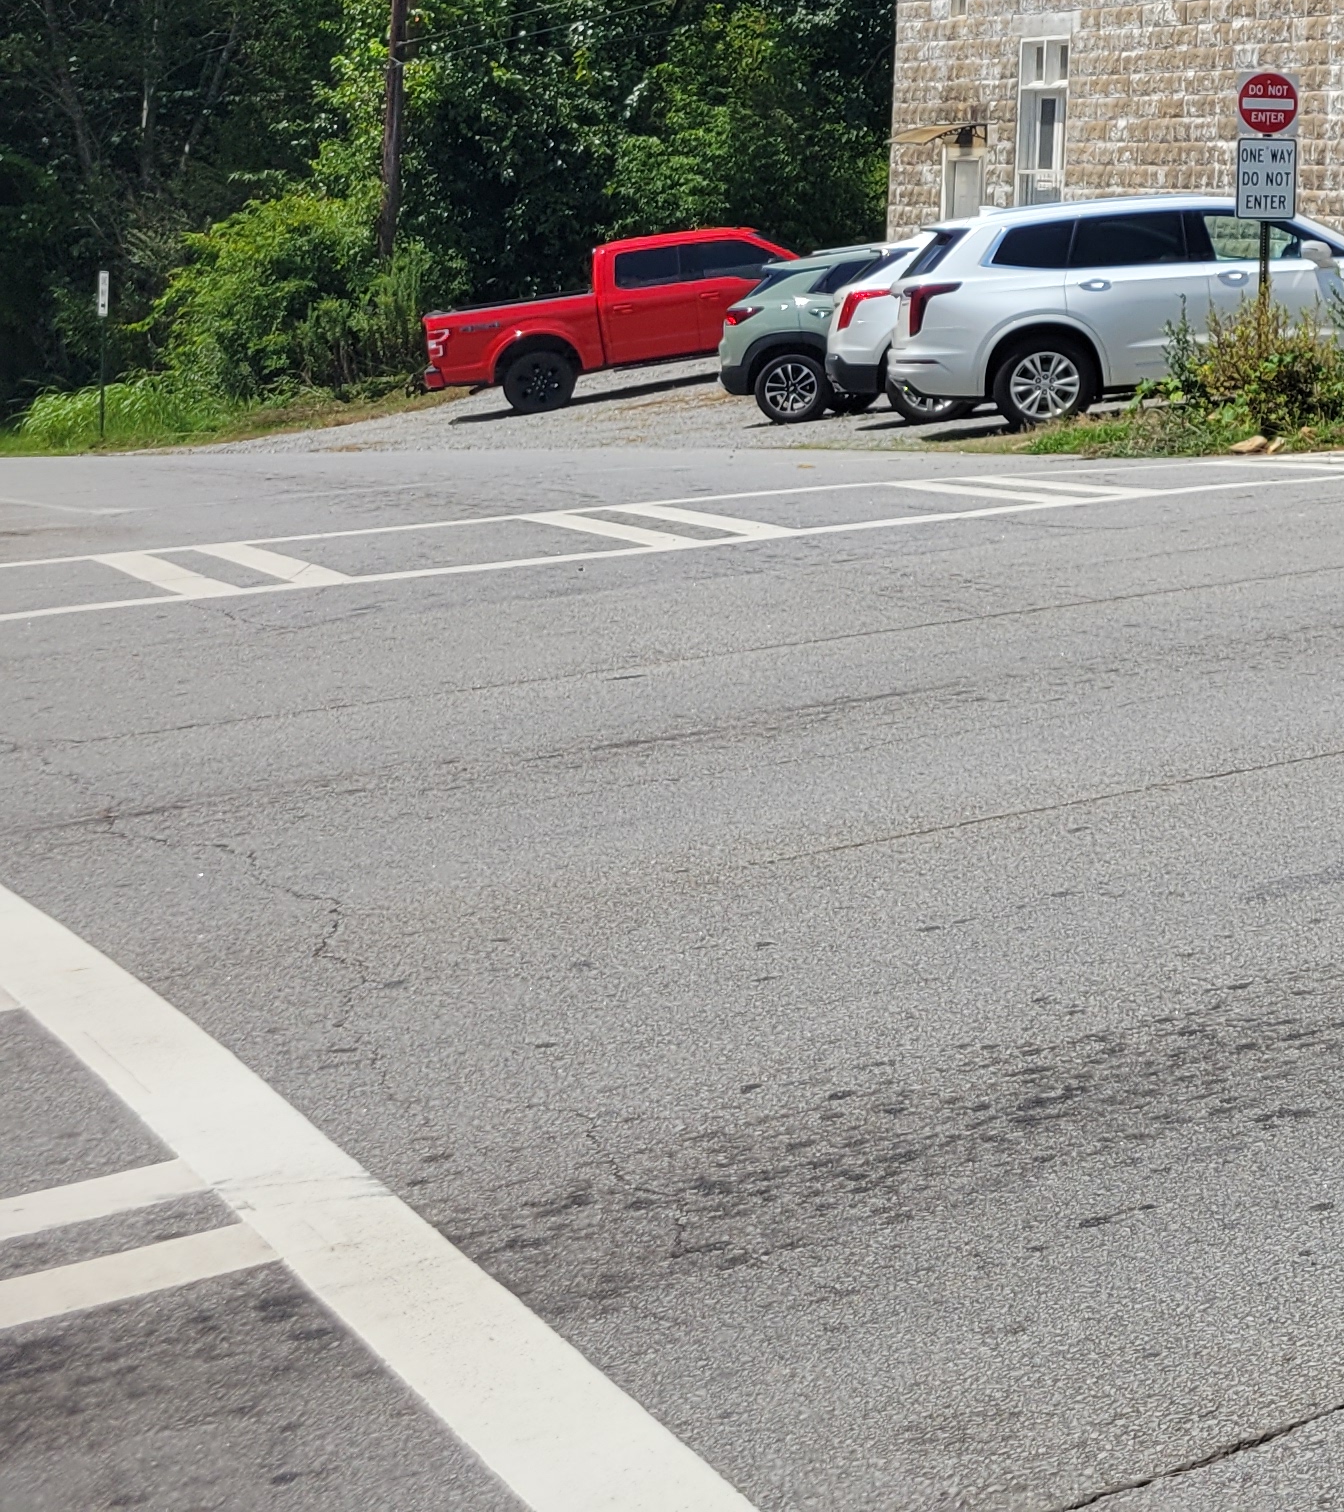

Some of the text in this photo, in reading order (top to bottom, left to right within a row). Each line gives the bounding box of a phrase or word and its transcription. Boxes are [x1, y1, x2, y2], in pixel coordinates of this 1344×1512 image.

[1248, 84, 1289, 96] DO NOT
[1251, 111, 1285, 125] ENTER
[1241, 148, 1293, 164] ONE WAY
[1242, 171, 1291, 187] DO NOT
[1245, 194, 1287, 211] ENTER
